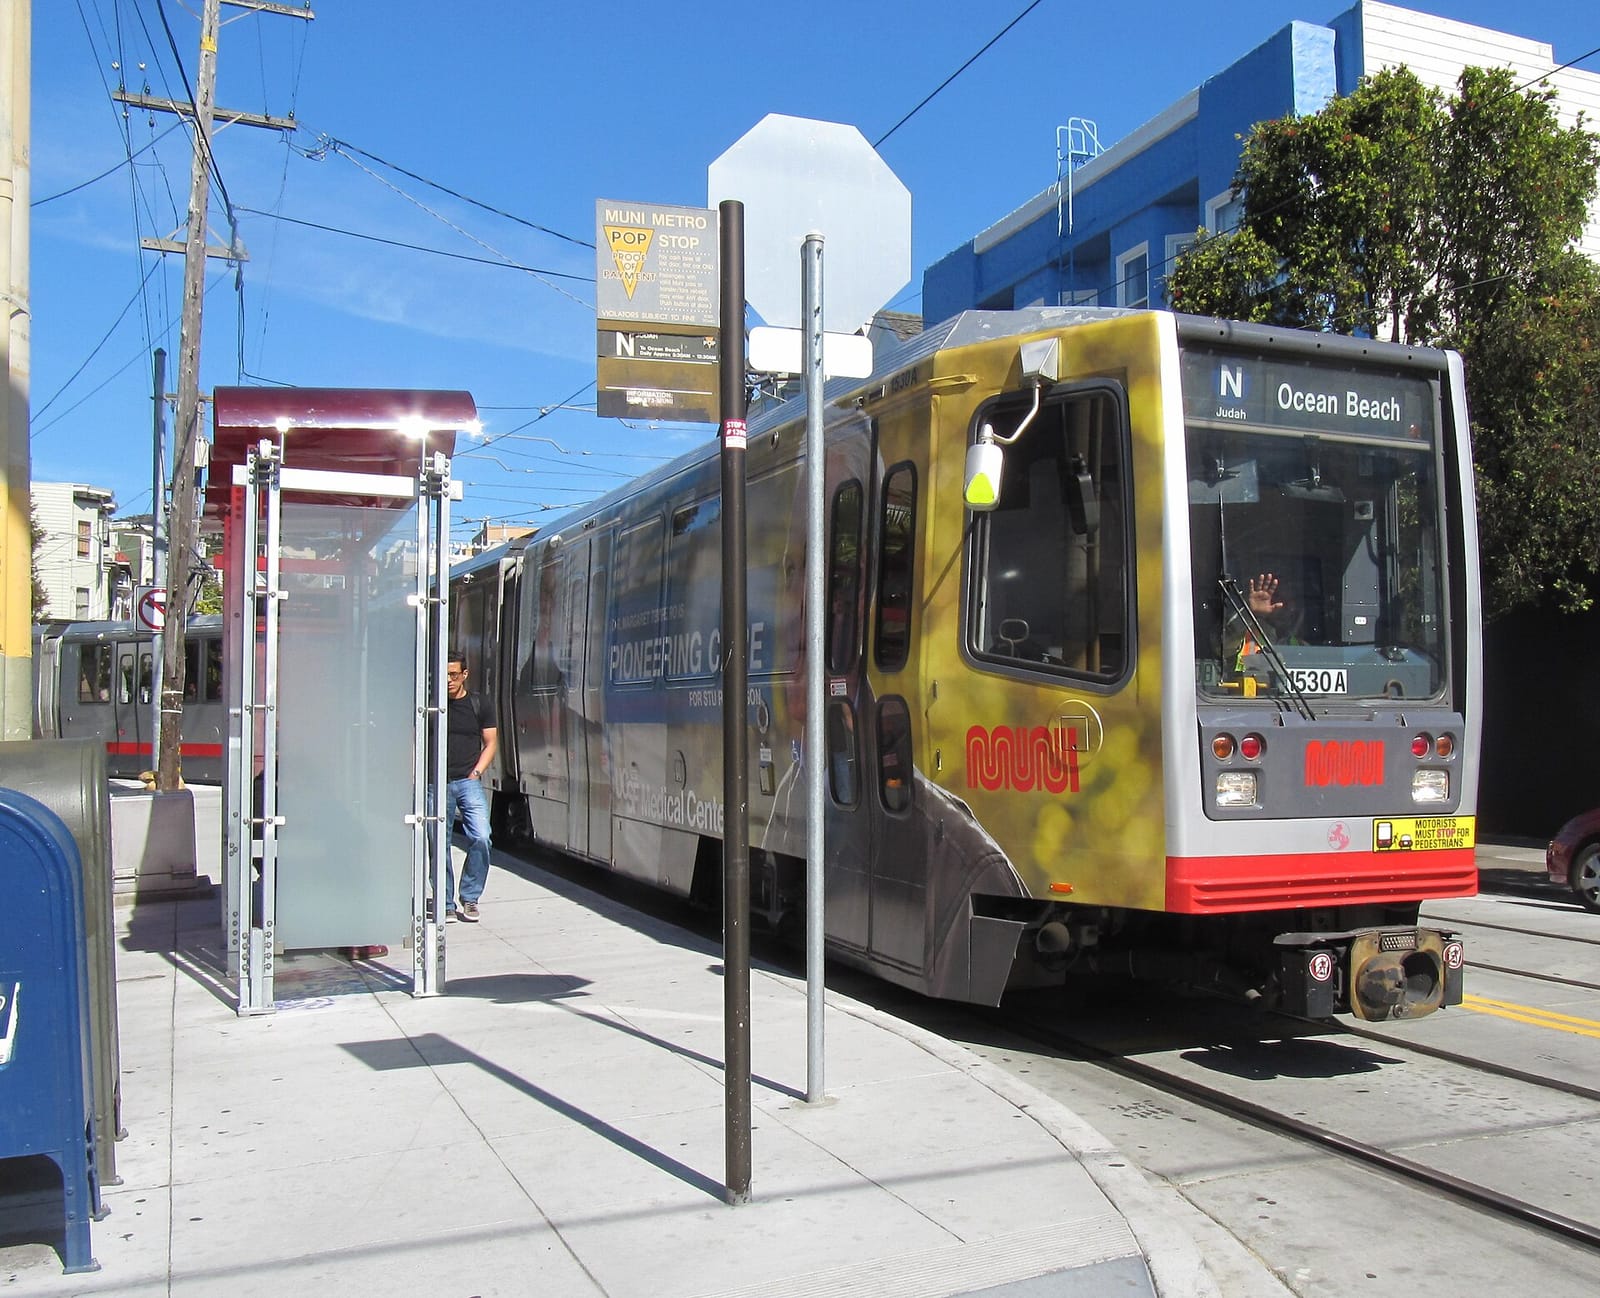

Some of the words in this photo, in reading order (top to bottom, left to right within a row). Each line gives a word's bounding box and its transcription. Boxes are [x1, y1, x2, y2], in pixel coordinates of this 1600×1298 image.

[605, 209, 645, 225] MUNI
[652, 213, 707, 229] METRO
[611, 231, 647, 245] POP
[659, 234, 699, 249] STOP
[613, 252, 646, 263] PROOF
[623, 263, 637, 271] OF
[603, 269, 656, 282] PAYMENT
[601, 310, 639, 319] VIOLATORS
[616, 331, 635, 357] N
[1219, 364, 1243, 398] N
[1277, 383, 1338, 415] Ocean
[1346, 391, 1400, 422] Beach
[1215, 407, 1247, 420] Judah
[610, 631, 702, 681] PIONEERING
[708, 622, 764, 673] CE
[688, 690, 702, 707] FOR
[966, 725, 1080, 794] MUNI
[1305, 740, 1385, 787] MUNI
[641, 783, 684, 825] Medical
[686, 790, 724, 834] Cente
[1415, 819, 1457, 829] MOTORISTS
[1415, 829, 1436, 839] MUST
[1436, 828, 1456, 838] STOP
[1457, 828, 1470, 837] FOR
[1415, 838, 1463, 849] PEDESTRIANS
